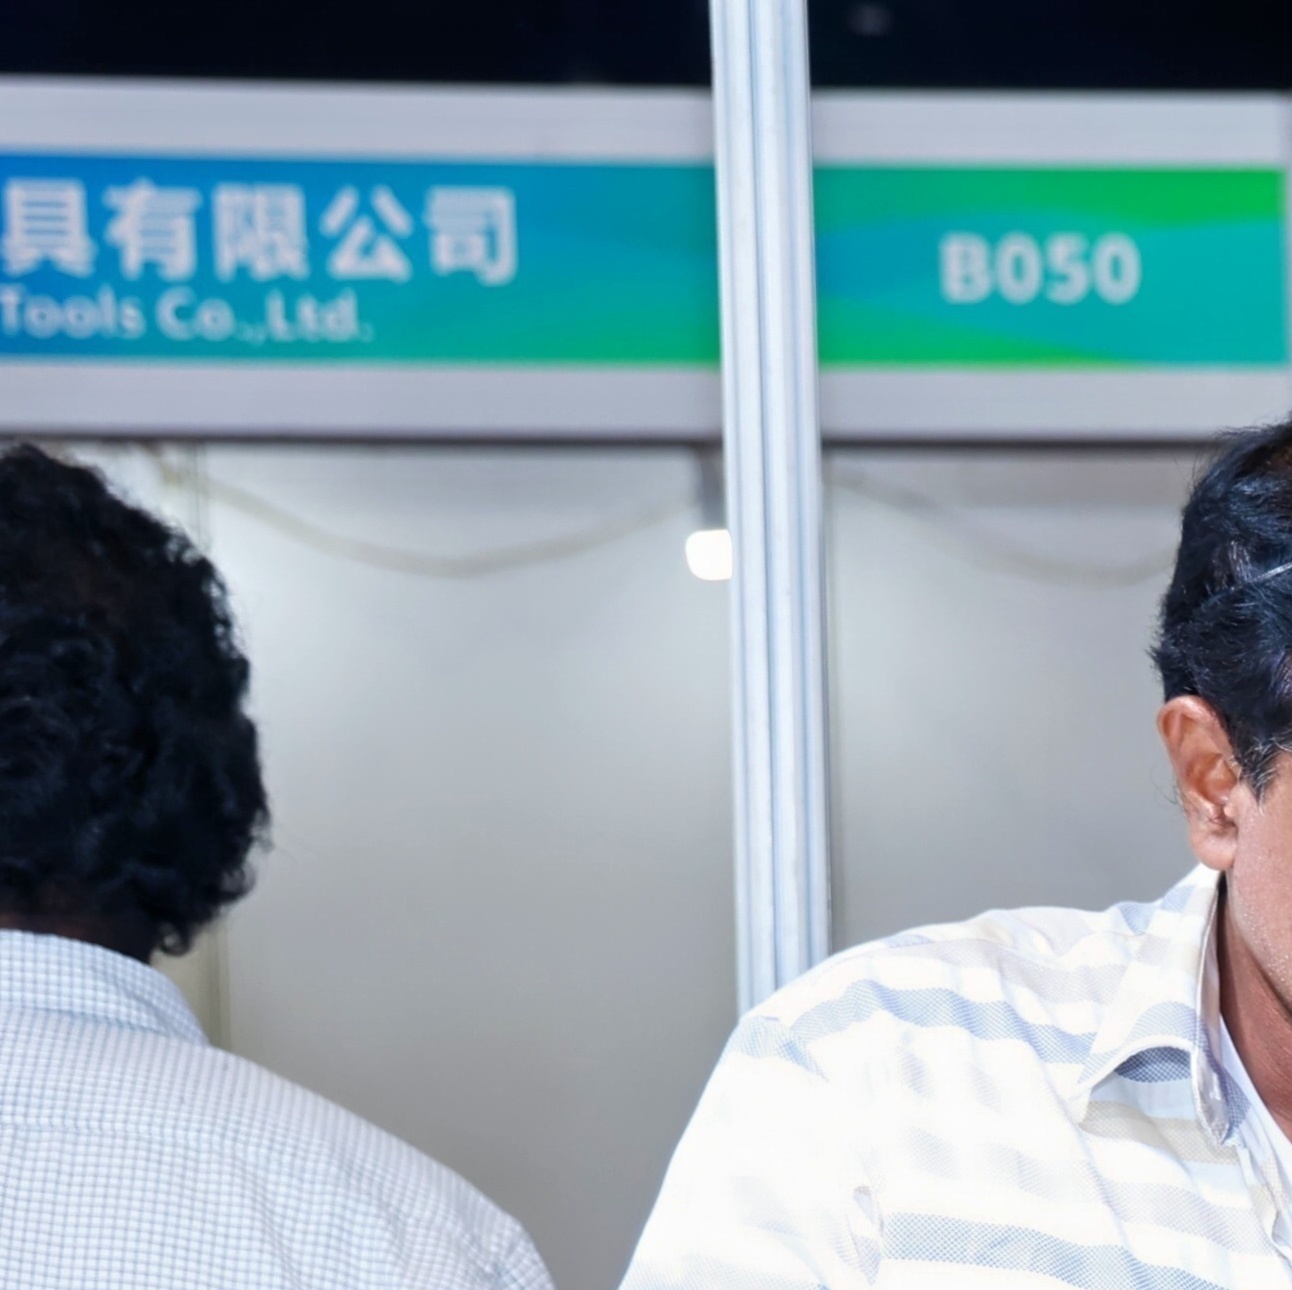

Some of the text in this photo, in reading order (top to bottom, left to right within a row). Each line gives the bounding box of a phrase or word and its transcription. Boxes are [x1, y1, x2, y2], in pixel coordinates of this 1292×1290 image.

[4, 177, 518, 284] 具有限公司
[939, 231, 1142, 305] B050
[0, 283, 147, 340] Tools
